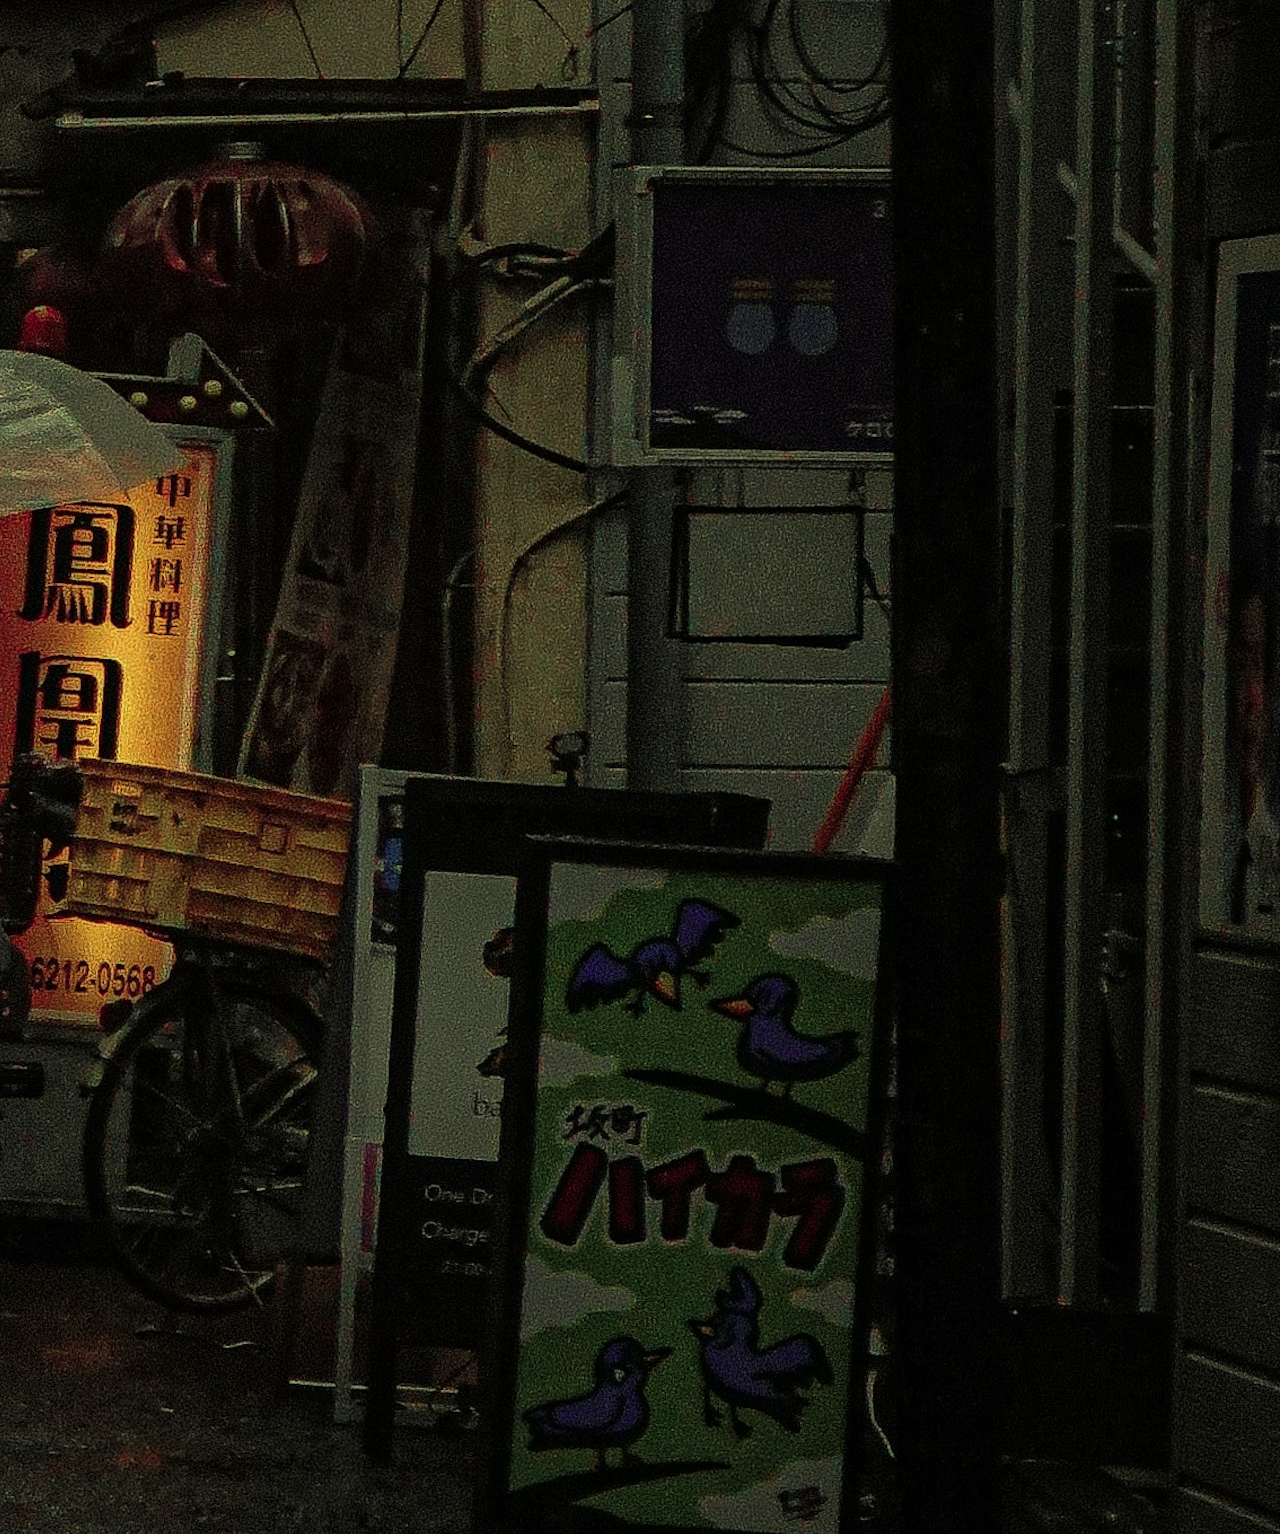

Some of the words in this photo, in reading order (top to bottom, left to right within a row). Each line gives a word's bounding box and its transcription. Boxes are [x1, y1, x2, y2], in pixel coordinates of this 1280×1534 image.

[146, 472, 192, 637] 中華料理
[541, 1141, 846, 1271] ハイカラ
